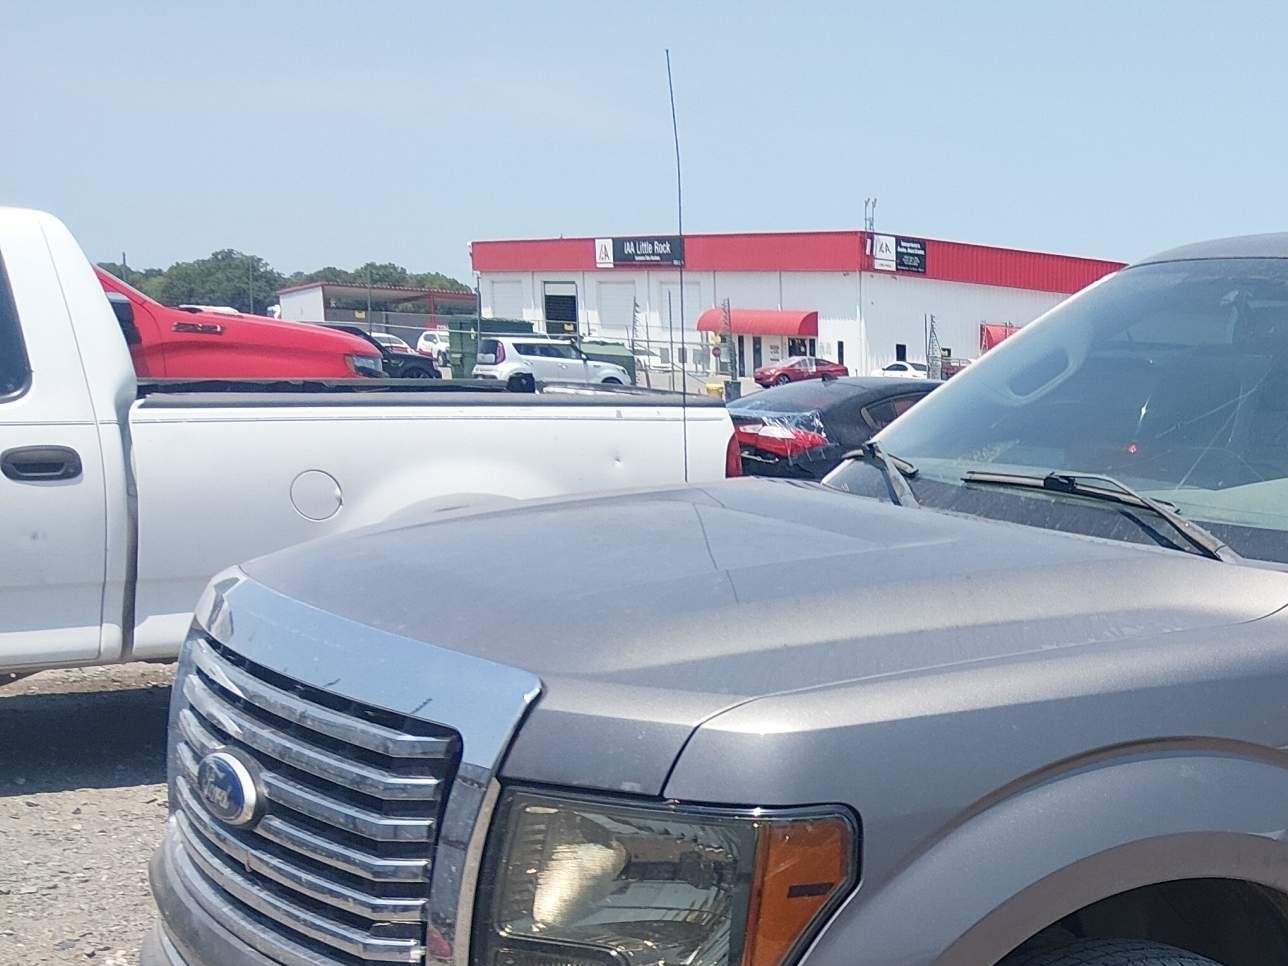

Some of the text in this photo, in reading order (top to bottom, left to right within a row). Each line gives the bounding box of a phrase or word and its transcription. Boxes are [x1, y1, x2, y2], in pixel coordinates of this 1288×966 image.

[623, 240, 635, 254] IAA
[636, 239, 653, 255] Little
[654, 240, 672, 254] Rock
